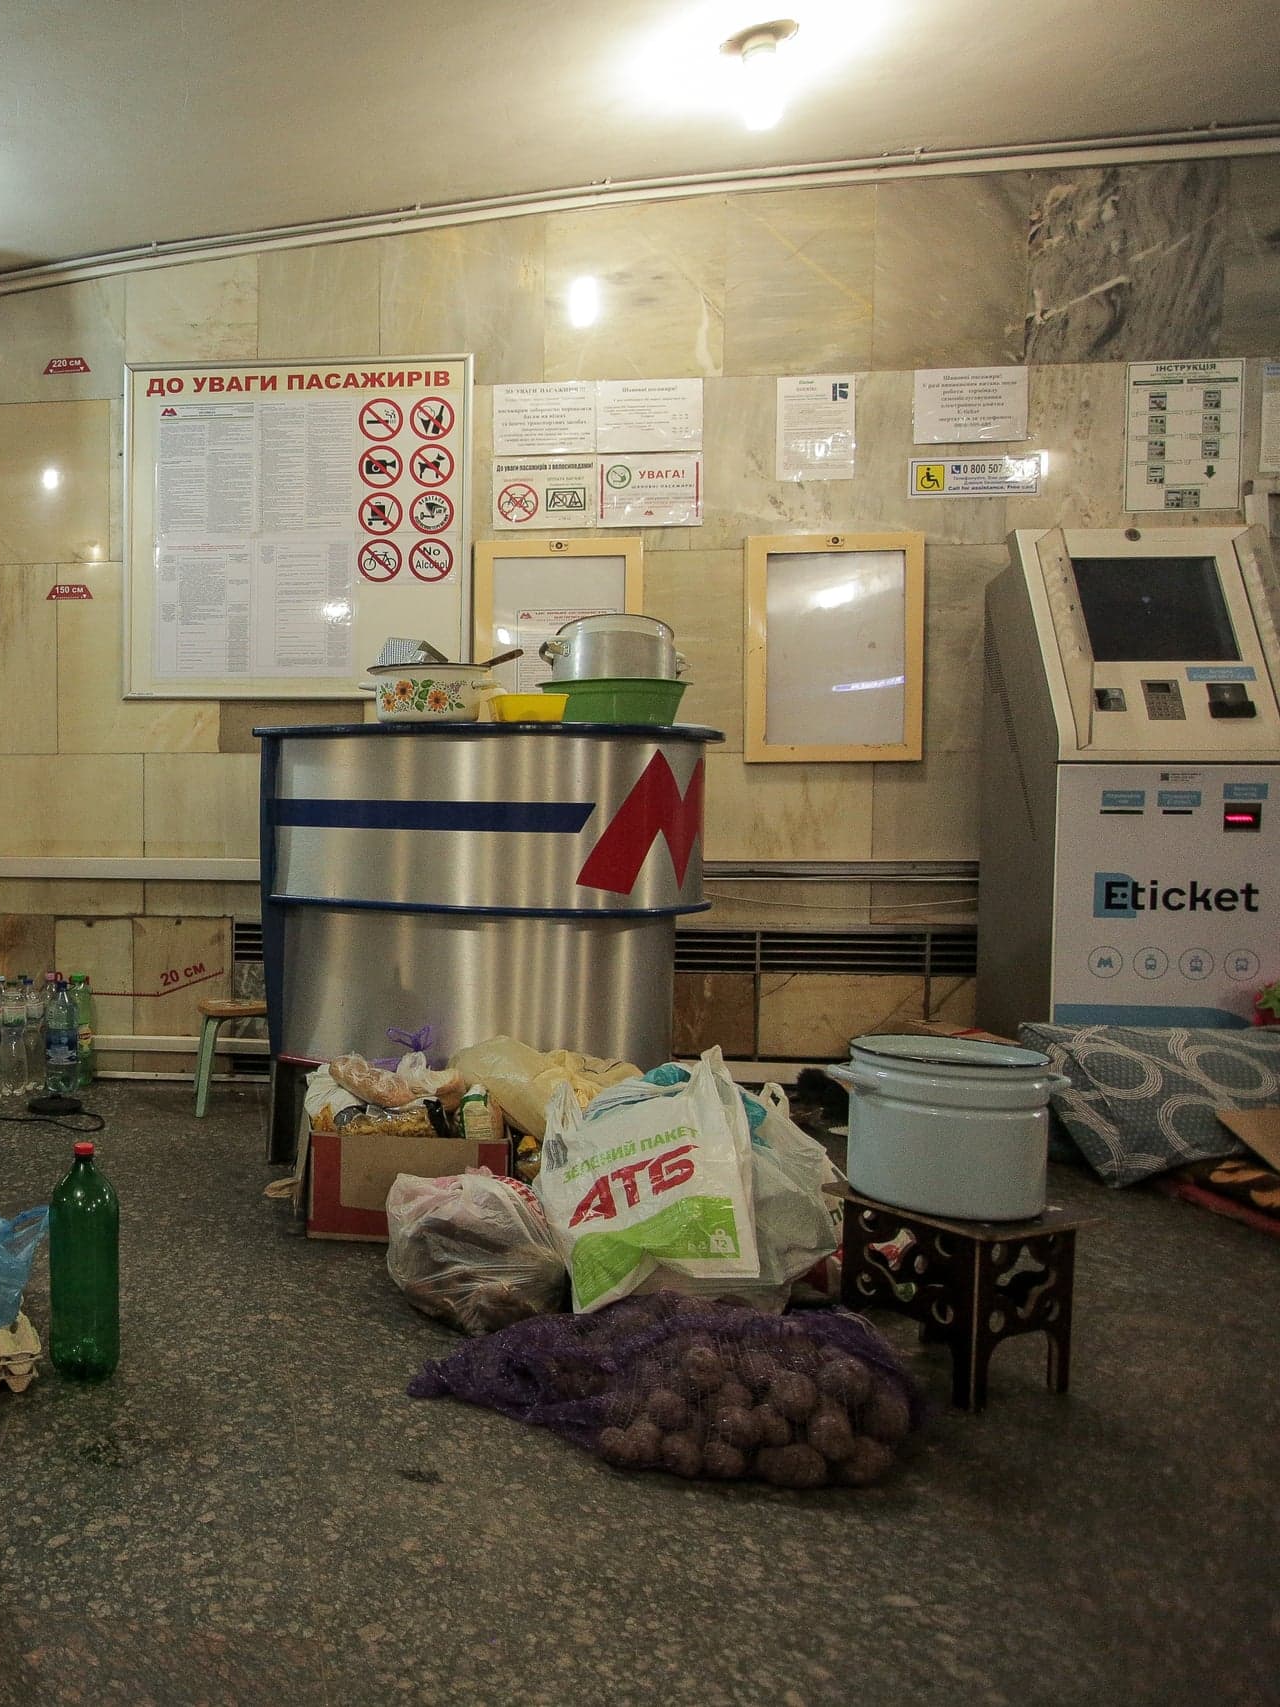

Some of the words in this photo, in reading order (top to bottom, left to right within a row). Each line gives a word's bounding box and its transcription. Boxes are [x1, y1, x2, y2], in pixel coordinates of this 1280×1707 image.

[51, 359, 67, 368] 220
[1156, 364, 1217, 372] ІНСТРУКЦІЯ
[146, 377, 184, 397] ДО
[193, 375, 278, 393] УВАГИ
[287, 370, 451, 390] ПАСАЖИРІВ
[962, 464, 968, 474] 0
[970, 464, 986, 474] 800
[638, 470, 685, 480] УВАГА!
[422, 546, 441, 556] No
[56, 586, 70, 594] 150
[1104, 880, 1259, 912] Eticket
[160, 970, 180, 986] 20
[563, 1139, 636, 1184] ЗЕЛЕНИЙ
[640, 1125, 700, 1151] ПАКЕТ
[568, 1144, 700, 1229] АТБ
